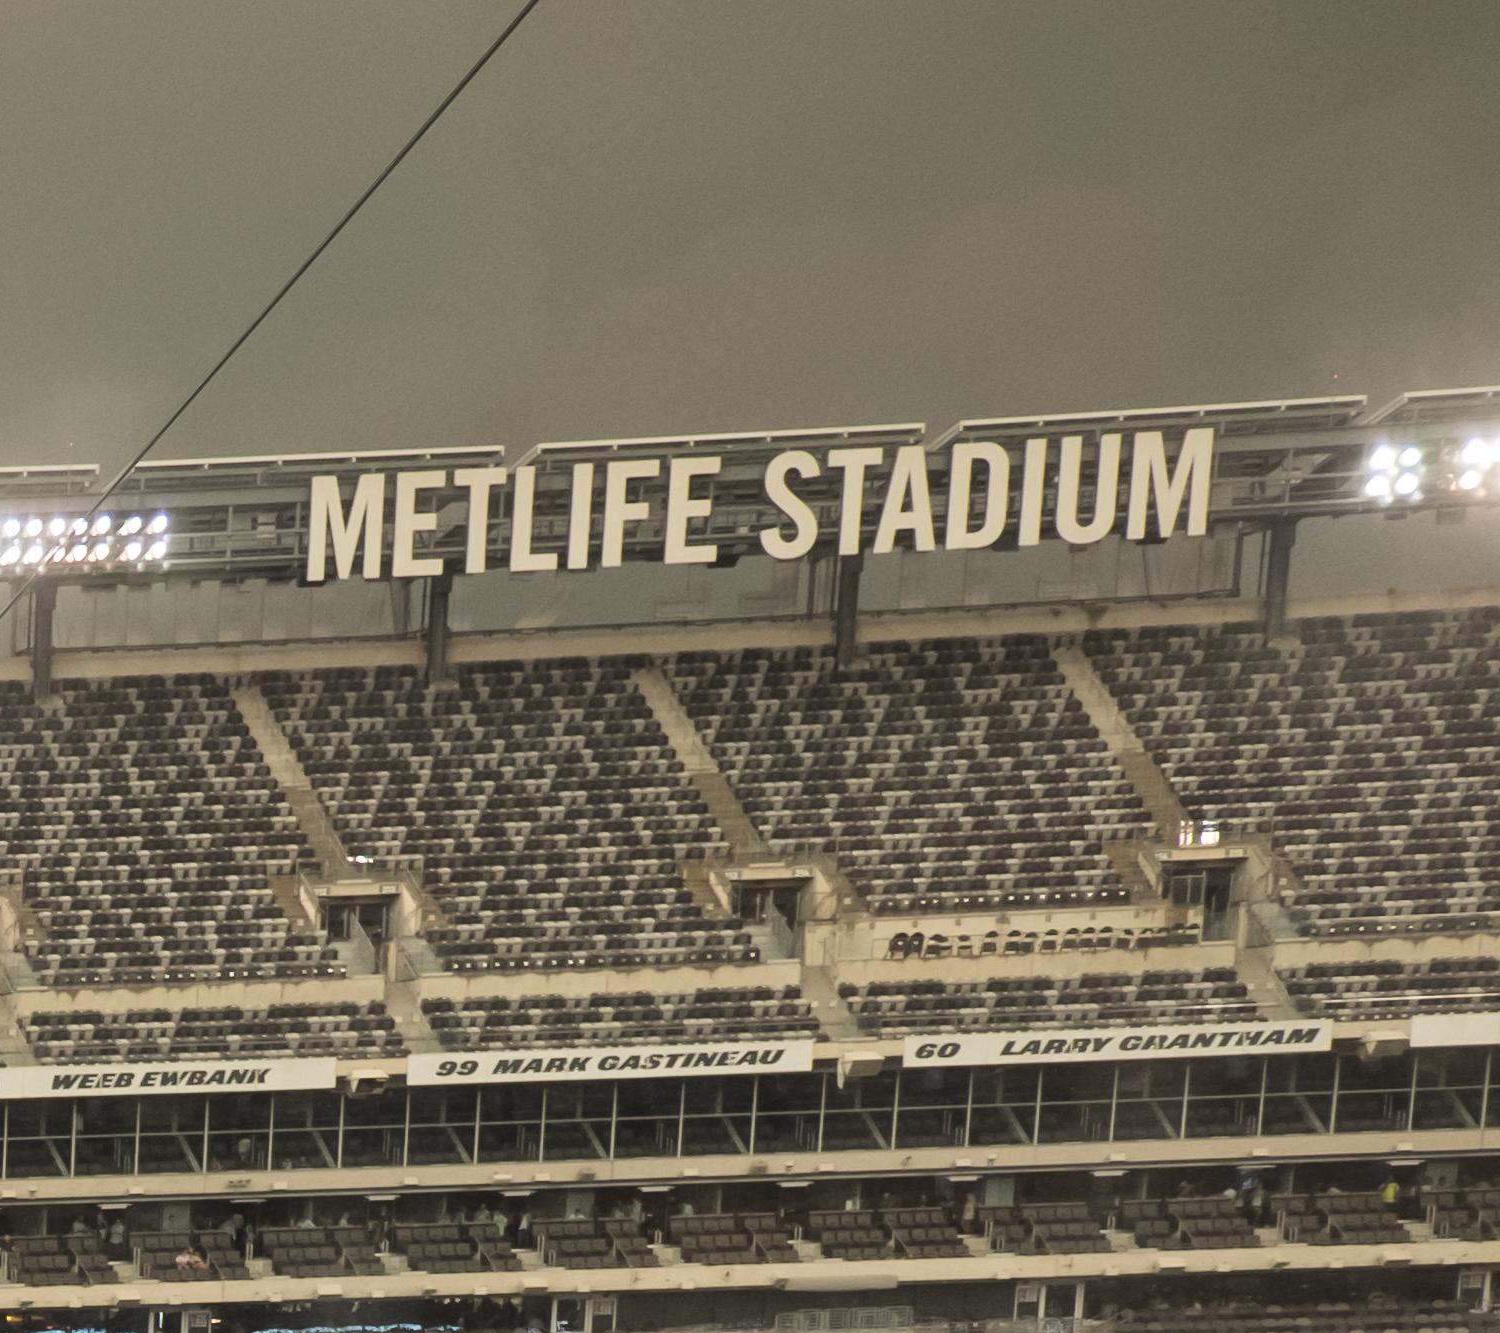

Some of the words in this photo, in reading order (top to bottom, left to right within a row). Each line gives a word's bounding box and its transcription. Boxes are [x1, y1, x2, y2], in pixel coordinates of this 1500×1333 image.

[307, 456, 721, 583] METLIFE
[761, 427, 1215, 560] STADIUM
[917, 1043, 960, 1059] 60
[1001, 1035, 1112, 1056] LARRY
[1119, 1028, 1319, 1052] GRANTHAM
[436, 1061, 479, 1076] 99
[493, 1056, 588, 1075] MARK
[597, 1050, 784, 1071] GASTINEAU
[52, 1072, 135, 1090] WEEB
[141, 1069, 270, 1088] EWBANK
